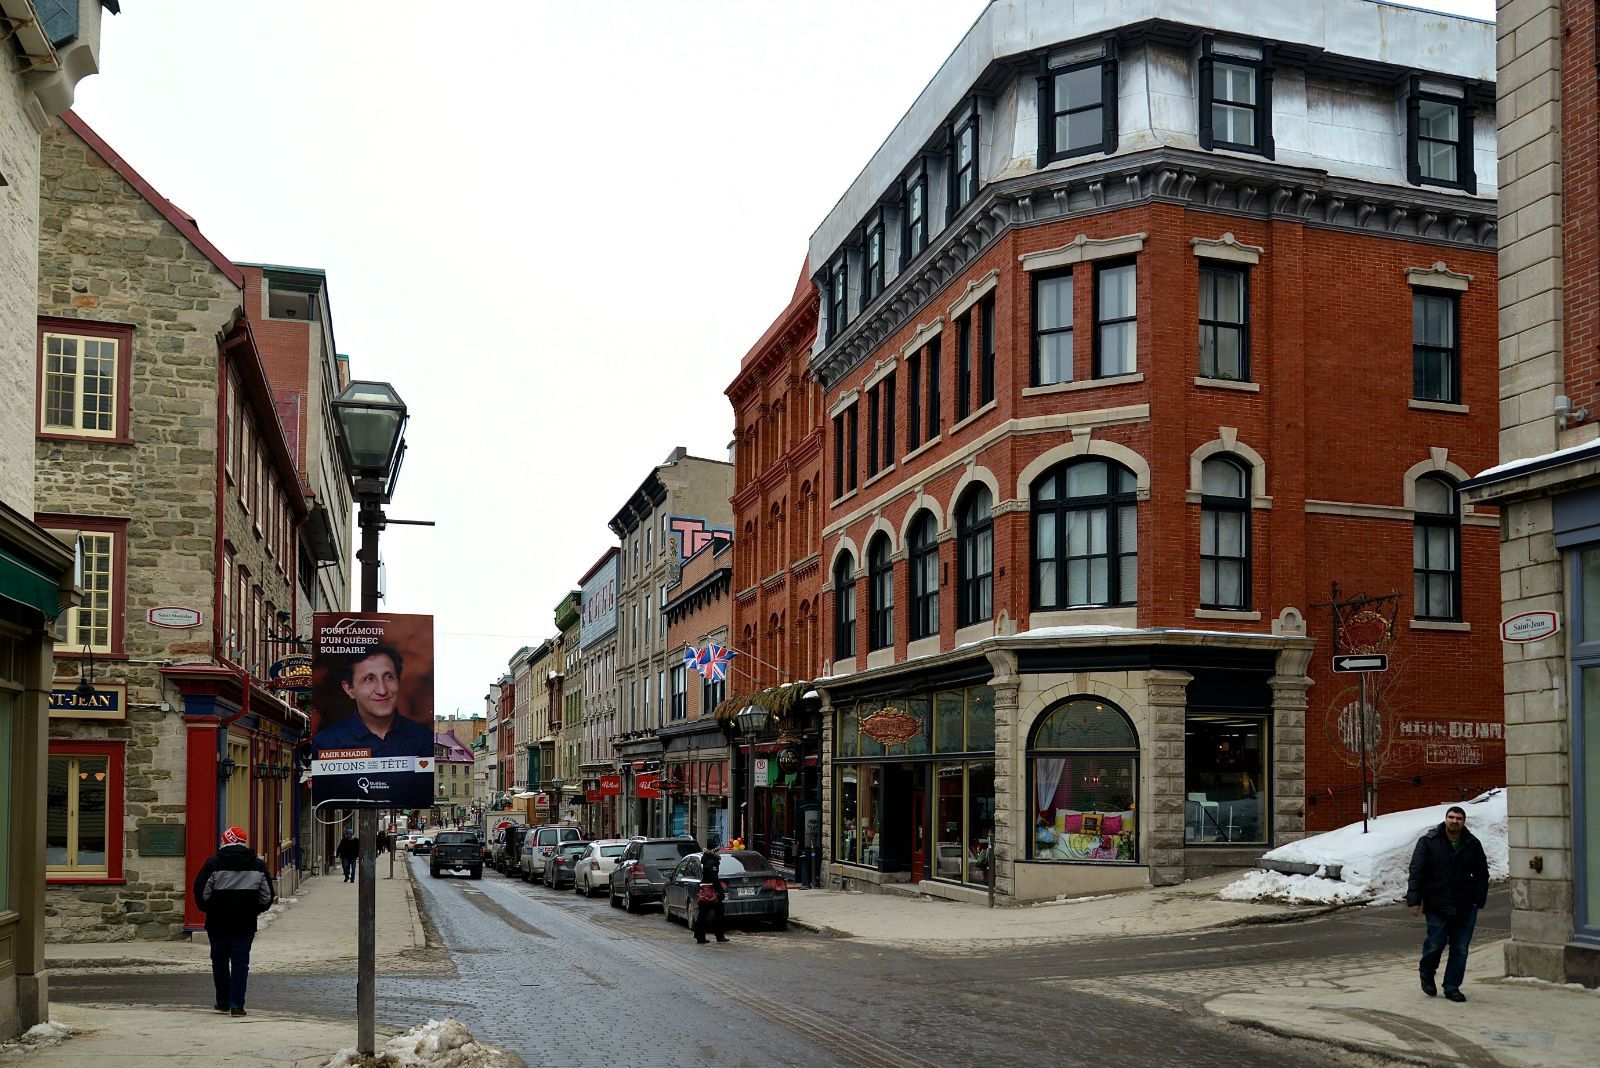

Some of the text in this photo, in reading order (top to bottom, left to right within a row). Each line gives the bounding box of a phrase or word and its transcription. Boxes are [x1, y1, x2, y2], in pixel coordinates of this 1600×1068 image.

[1513, 620, 1545, 631] Saint-Jean
[320, 627, 385, 635] POUR L'AMOUR
[320, 635, 379, 645] D'UN QUÉBEC
[320, 646, 366, 654] SOLIDAIRE
[320, 750, 369, 759] AMIR KHADIR
[320, 761, 366, 772] VOTONS
[380, 758, 409, 769] TÊTE
